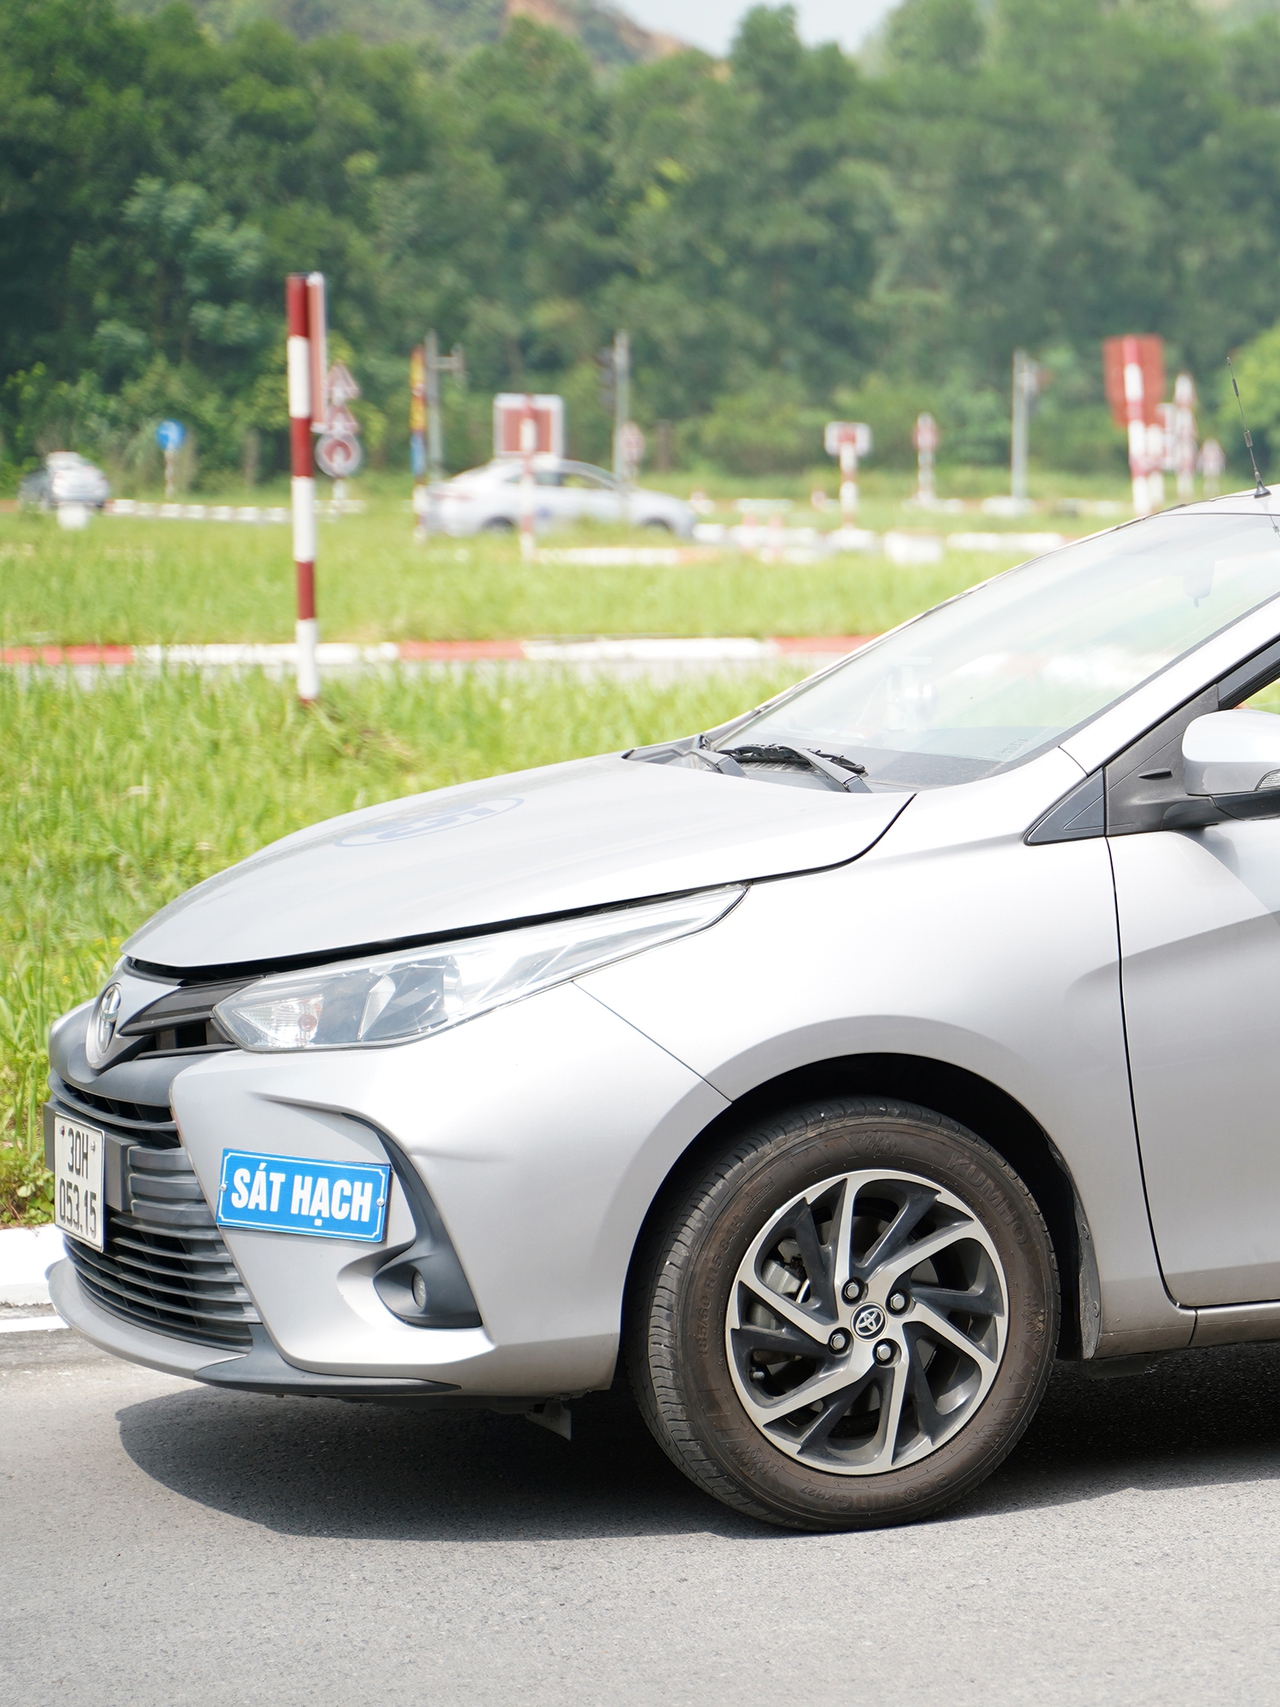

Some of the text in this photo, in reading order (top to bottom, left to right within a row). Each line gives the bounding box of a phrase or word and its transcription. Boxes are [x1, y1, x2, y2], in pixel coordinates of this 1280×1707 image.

[67, 1127, 89, 1180] 30H
[59, 1178, 97, 1239] 053.15
[230, 1162, 374, 1227] SÁT HẠCH
[947, 1152, 1029, 1246] KUMHO
